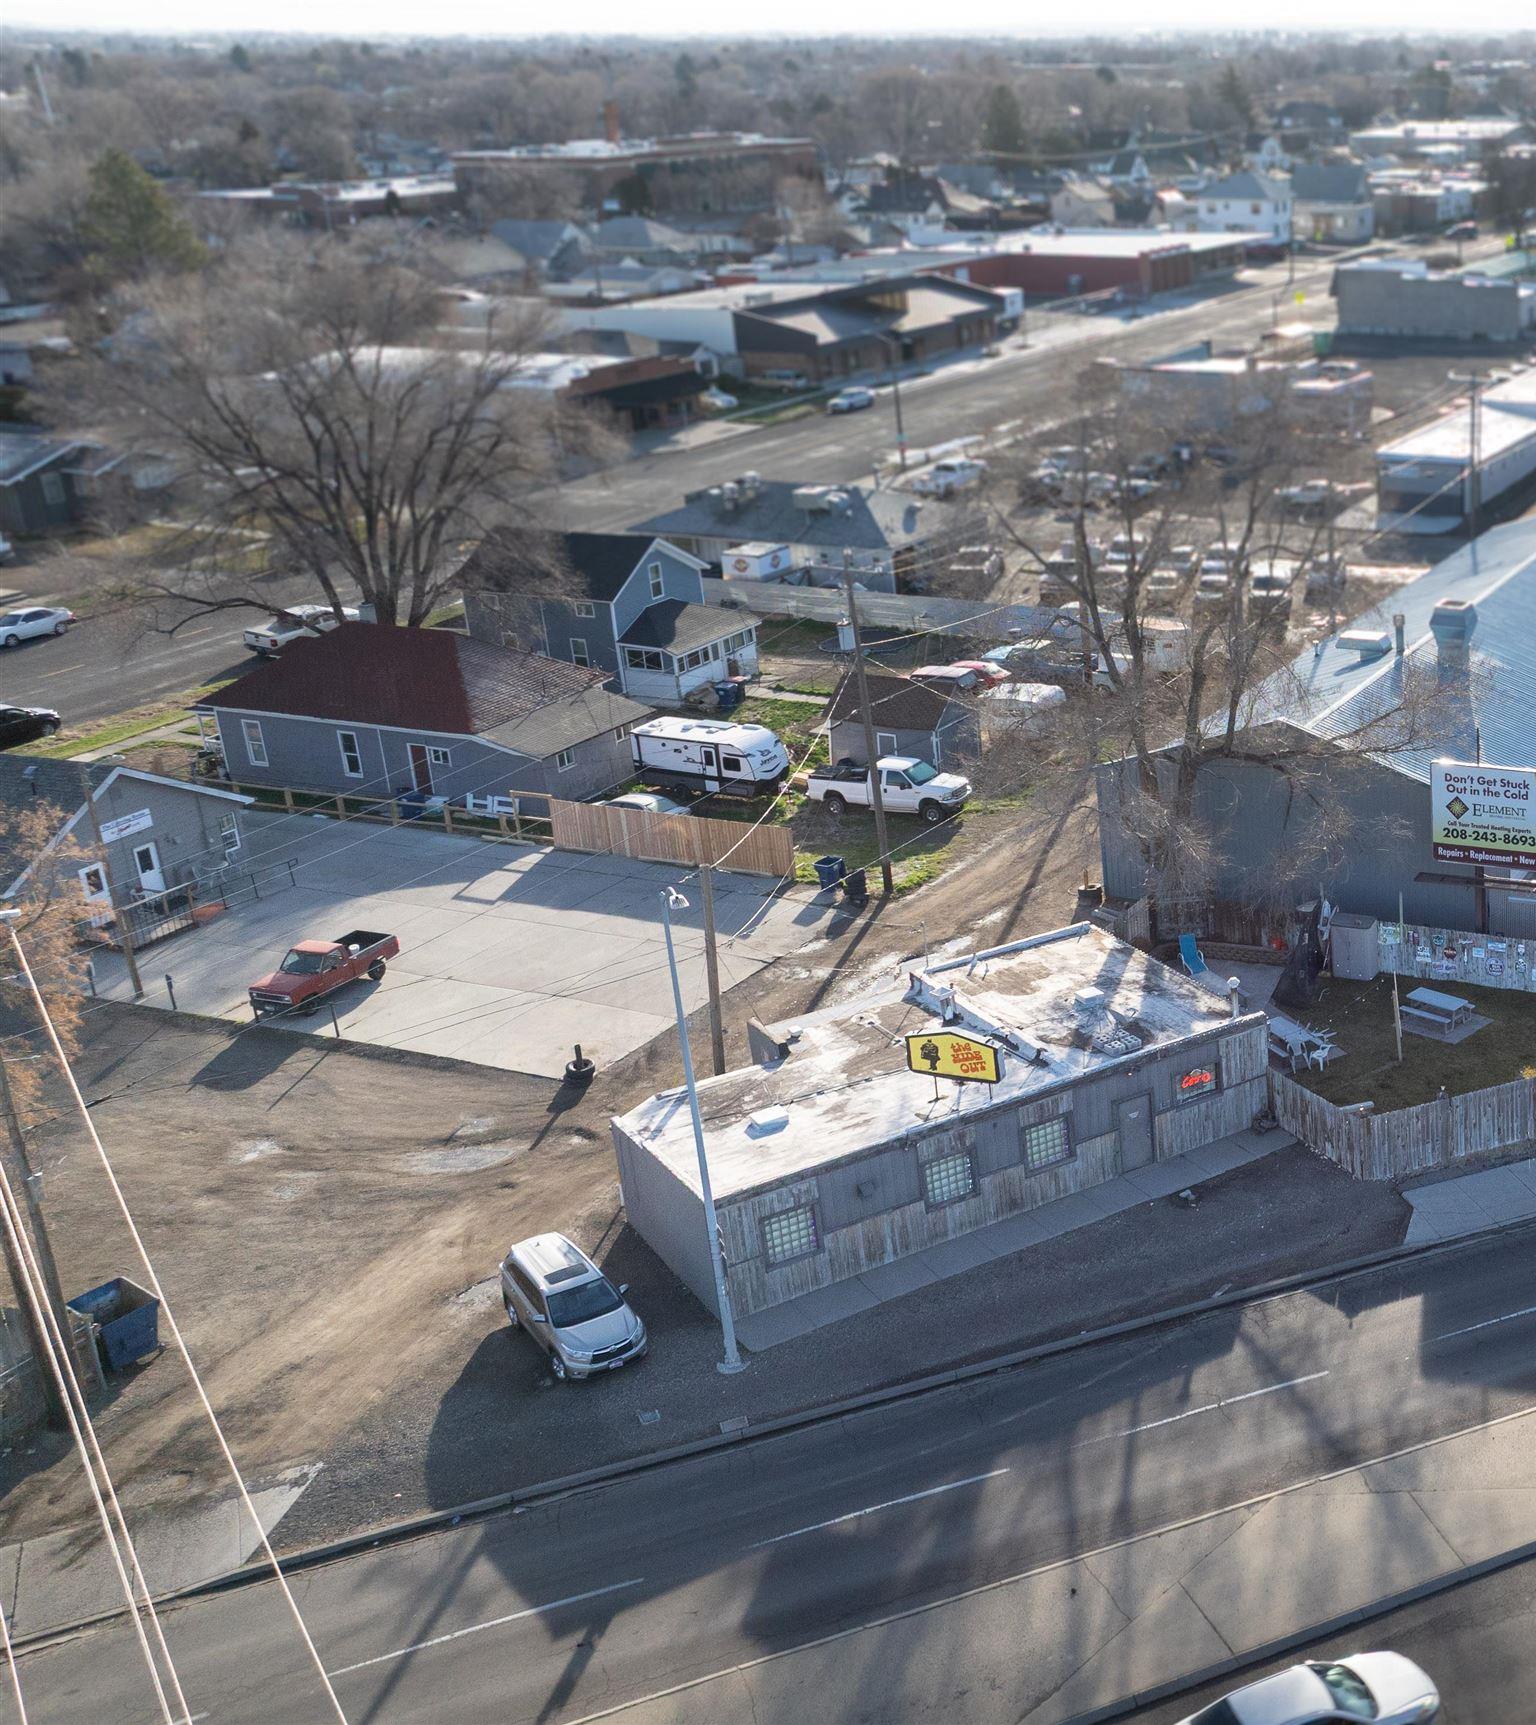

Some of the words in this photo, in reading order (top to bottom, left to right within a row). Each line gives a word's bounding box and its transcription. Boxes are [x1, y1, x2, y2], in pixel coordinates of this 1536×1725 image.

[1444, 773, 1474, 784] Don't
[1477, 776, 1497, 786] Get
[1500, 778, 1530, 790] Stuck
[1446, 784, 1467, 794] Out
[1470, 786, 1480, 796] in
[1482, 787, 1500, 797] the
[1504, 790, 1529, 800] Cold
[1472, 803, 1527, 817] ELEMENT
[1491, 825, 1511, 833] Heating
[1442, 828, 1536, 847] 208-243-8693
[1438, 847, 1464, 858] Repairs
[1470, 850, 1513, 862] Replacement
[1520, 856, 1536, 865] New
[951, 1042, 972, 1053] the
[960, 1061, 986, 1074] OUT
